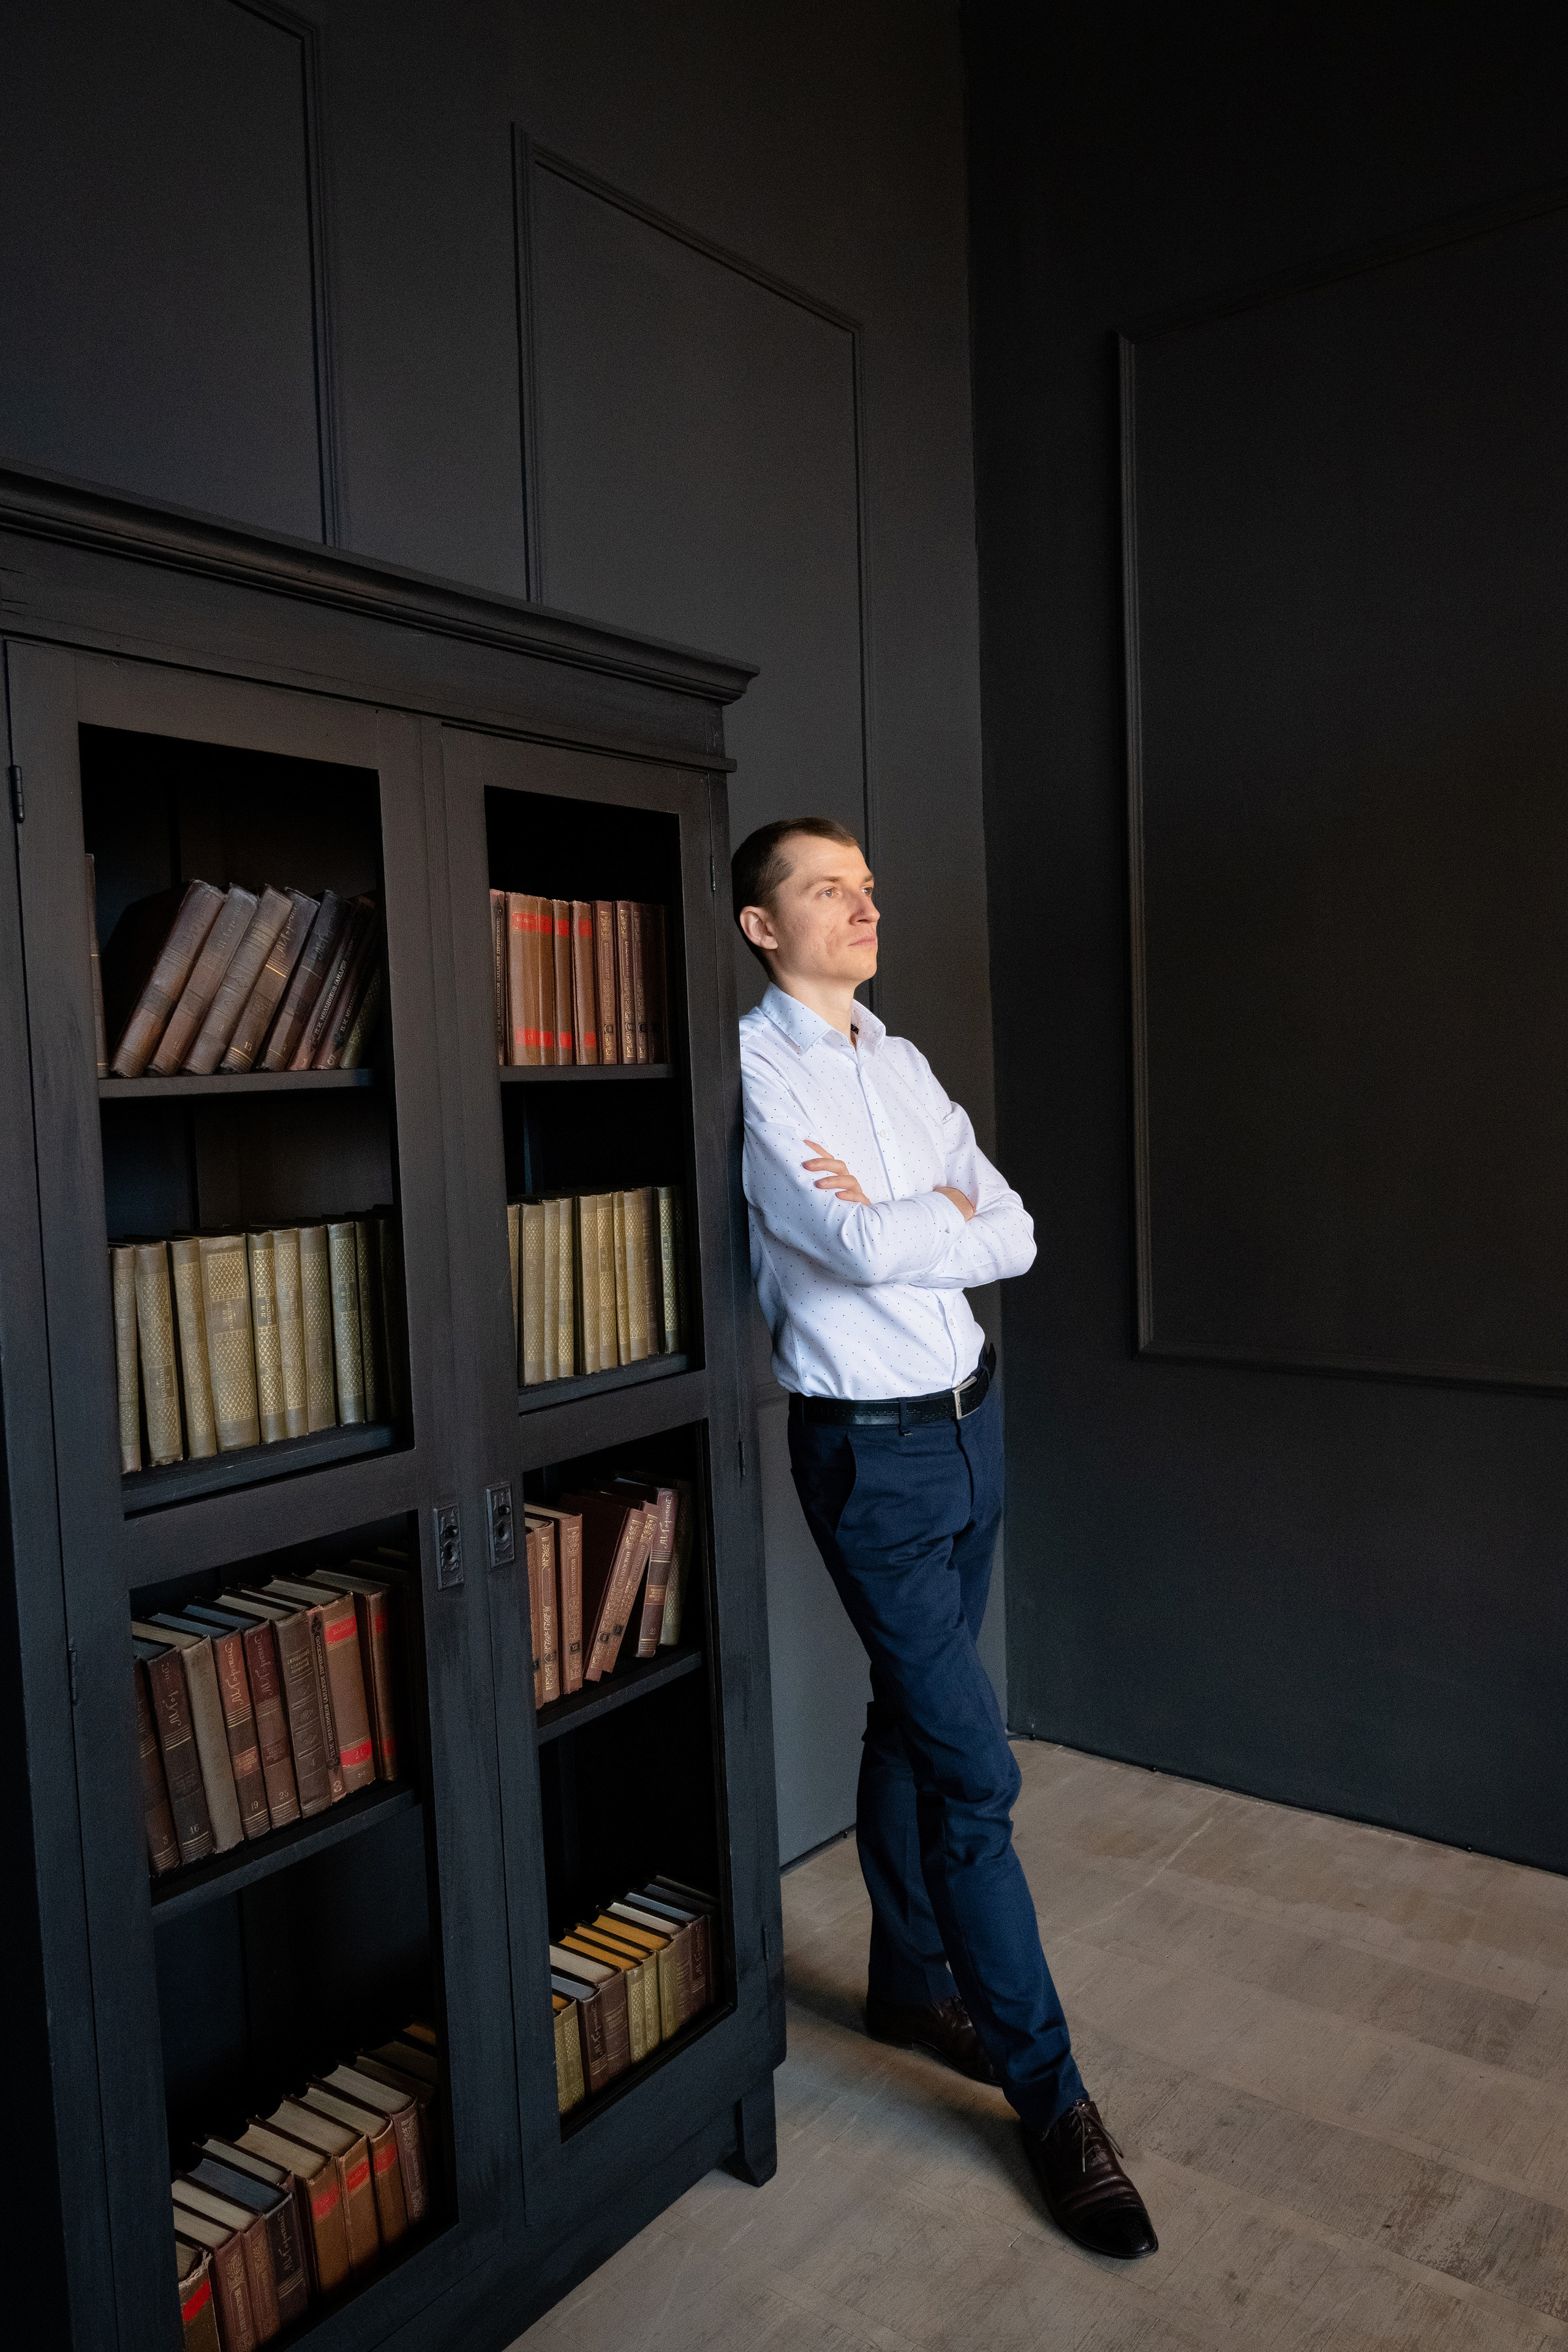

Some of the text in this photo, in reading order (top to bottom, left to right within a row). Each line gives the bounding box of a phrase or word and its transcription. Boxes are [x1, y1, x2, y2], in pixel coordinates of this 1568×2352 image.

[243, 1041, 253, 1051] 15
[330, 1779, 344, 1793] 3
[277, 1789, 290, 1800] 25
[249, 1800, 260, 1811] 19
[188, 1823, 200, 1834] 16
